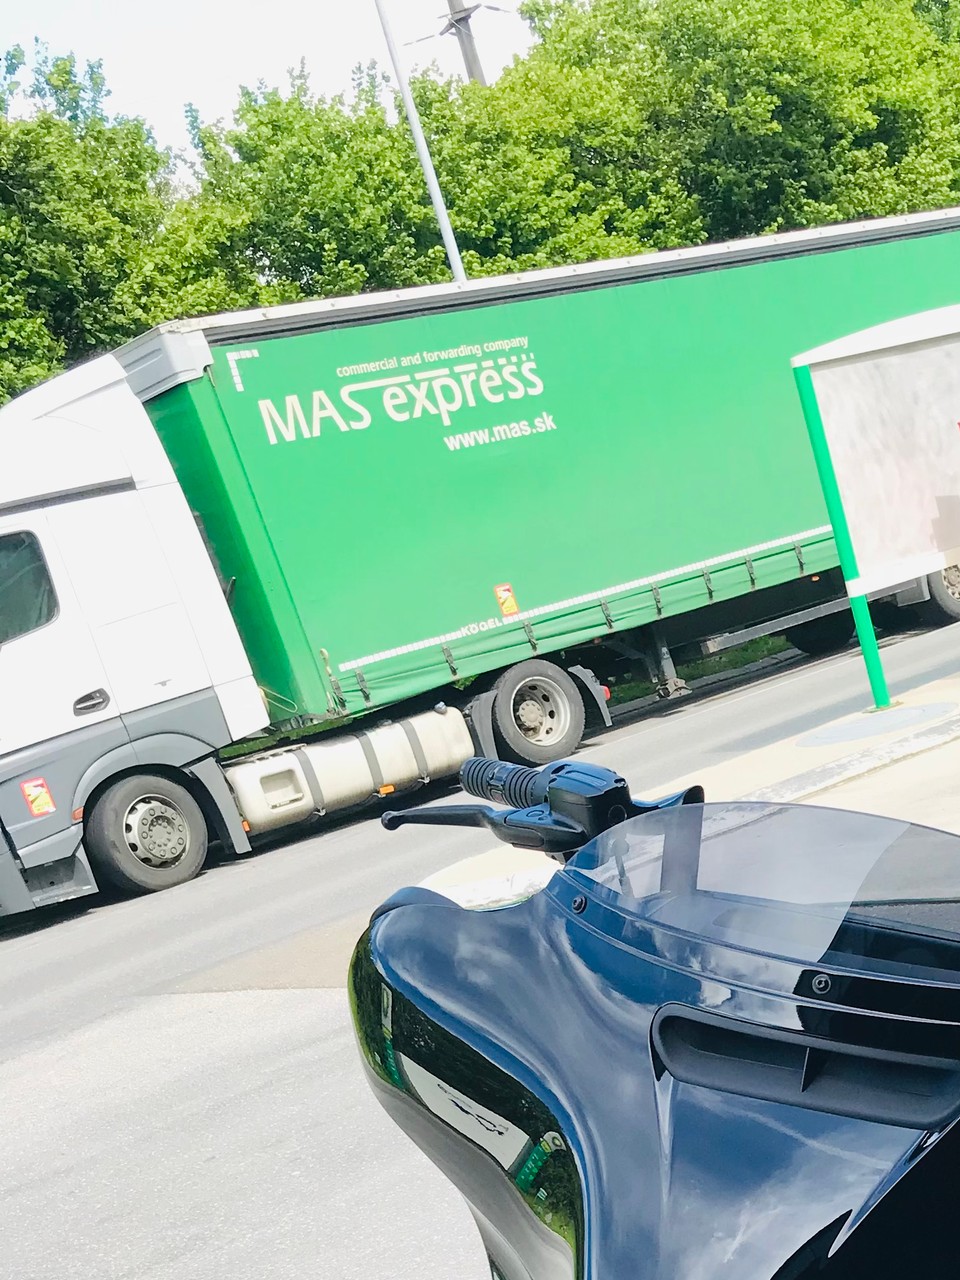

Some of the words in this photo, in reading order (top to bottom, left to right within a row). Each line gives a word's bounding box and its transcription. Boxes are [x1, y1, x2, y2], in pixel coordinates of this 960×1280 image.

[336, 356, 398, 377] commercial
[401, 352, 422, 367] and
[423, 344, 482, 363] forwarding
[483, 336, 528, 352] company
[258, 382, 372, 445] MAS
[382, 361, 544, 426] express
[443, 411, 557, 452] www.mas.sk
[460, 617, 503, 638] KÖGEL
